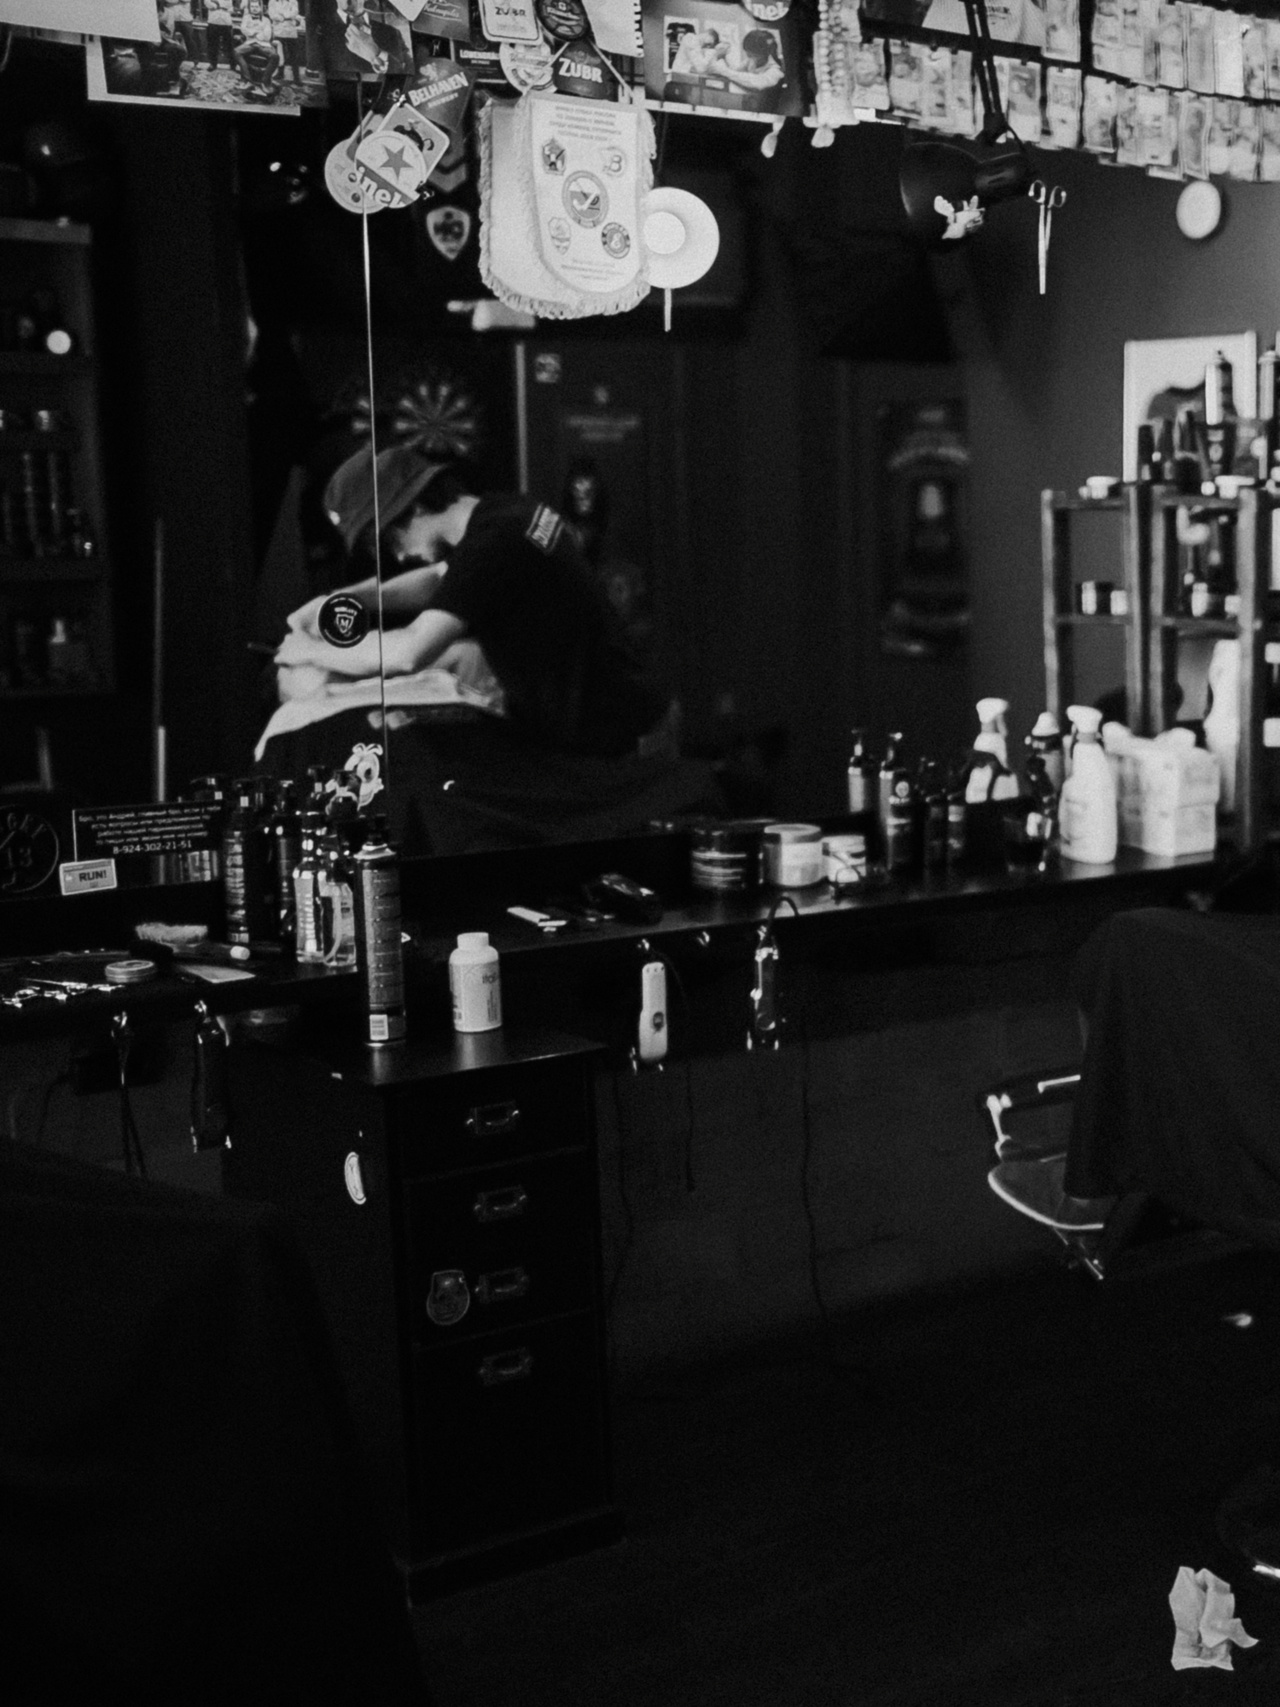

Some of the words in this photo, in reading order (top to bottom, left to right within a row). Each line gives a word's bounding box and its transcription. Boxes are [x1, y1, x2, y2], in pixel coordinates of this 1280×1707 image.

[558, 57, 603, 84] ZUBR
[408, 71, 469, 107] BELHAVEN
[79, 869, 108, 884] RUN!
